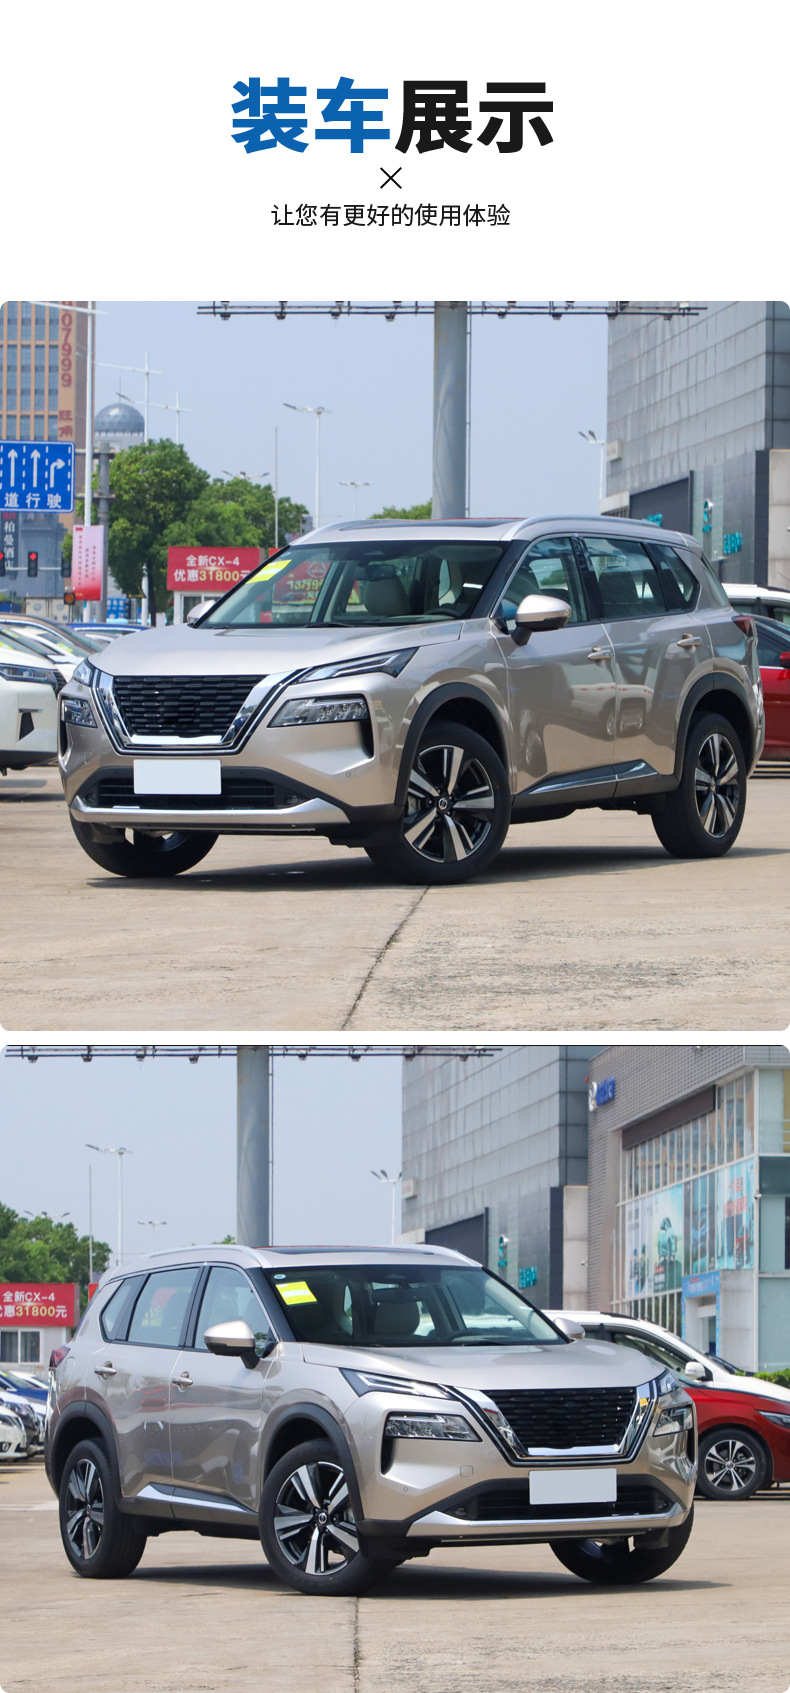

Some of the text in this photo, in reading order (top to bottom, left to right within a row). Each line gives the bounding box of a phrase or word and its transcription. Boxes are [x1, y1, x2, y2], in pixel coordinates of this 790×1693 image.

[4, 492, 62, 508] 道行驶
[186, 555, 240, 567] 全新CX-4
[3, 1291, 56, 1302] 全新CX-4
[0, 1305, 67, 1318] 惠31800元
